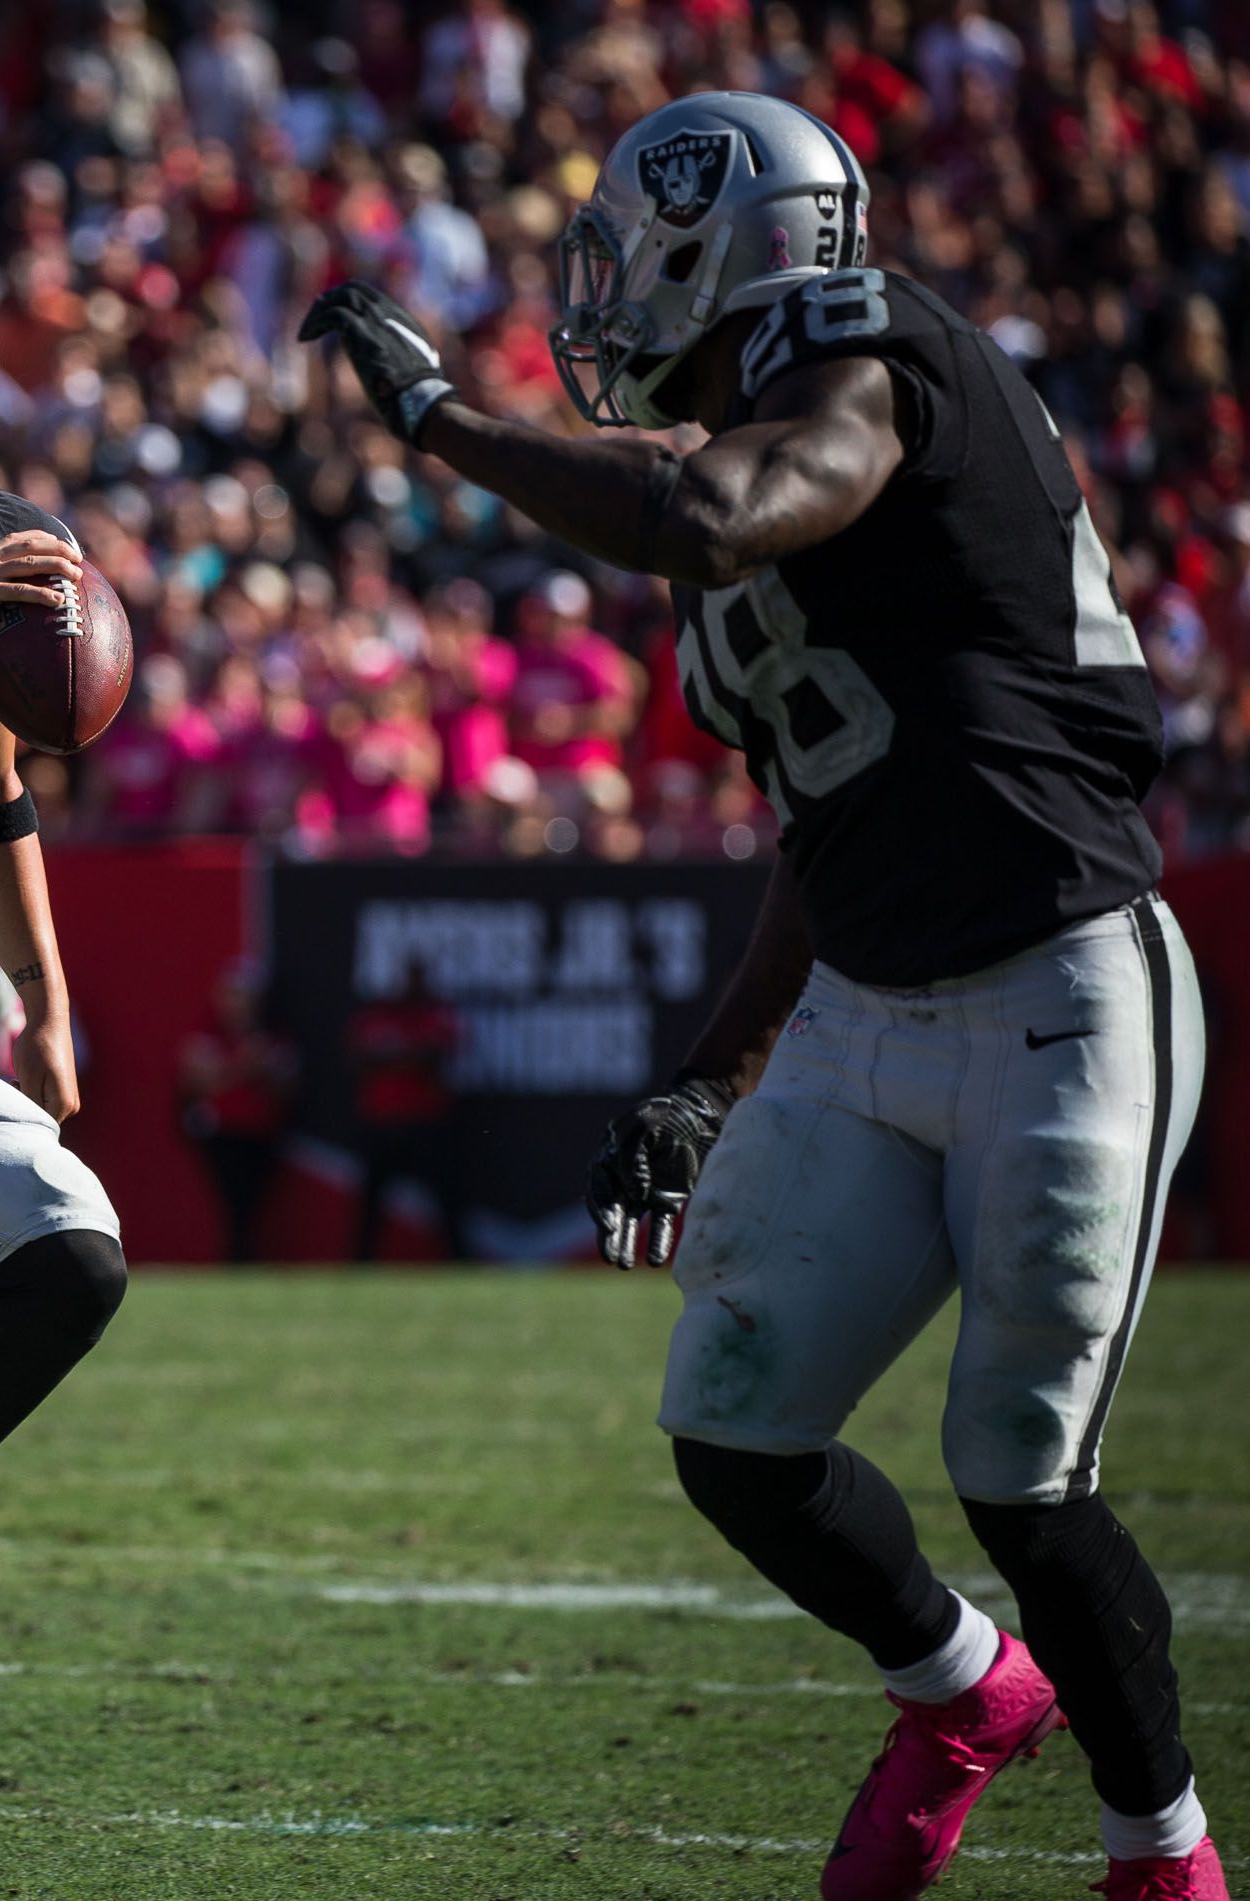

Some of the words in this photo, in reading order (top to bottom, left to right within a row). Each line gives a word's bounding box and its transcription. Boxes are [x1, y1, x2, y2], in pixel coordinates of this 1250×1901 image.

[646, 136, 722, 160] RAIDERS
[818, 194, 836, 210] AL
[740, 267, 890, 398] 28
